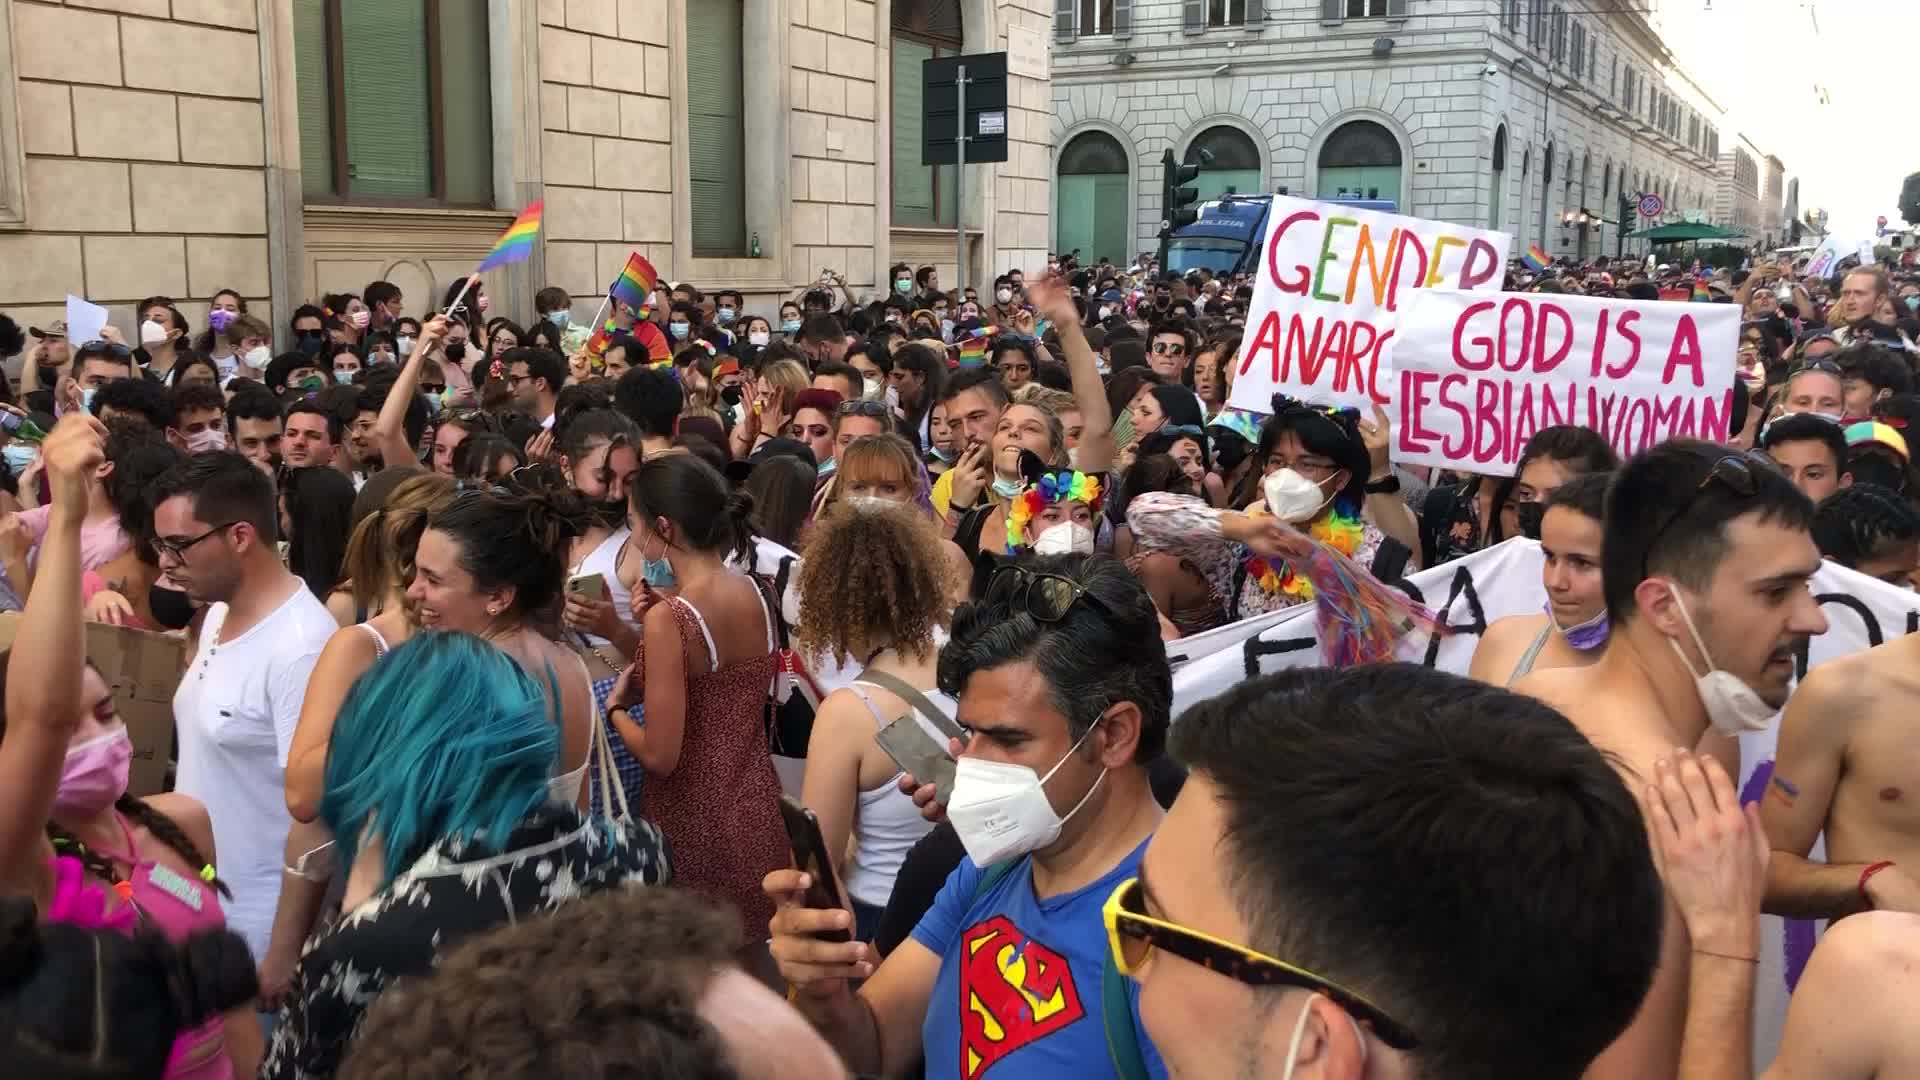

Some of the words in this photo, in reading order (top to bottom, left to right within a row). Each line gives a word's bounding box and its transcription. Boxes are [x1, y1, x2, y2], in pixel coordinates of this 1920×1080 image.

[1452, 297, 1574, 373] GOD
[1590, 308, 1641, 380] IS
[1662, 313, 1705, 387] A
